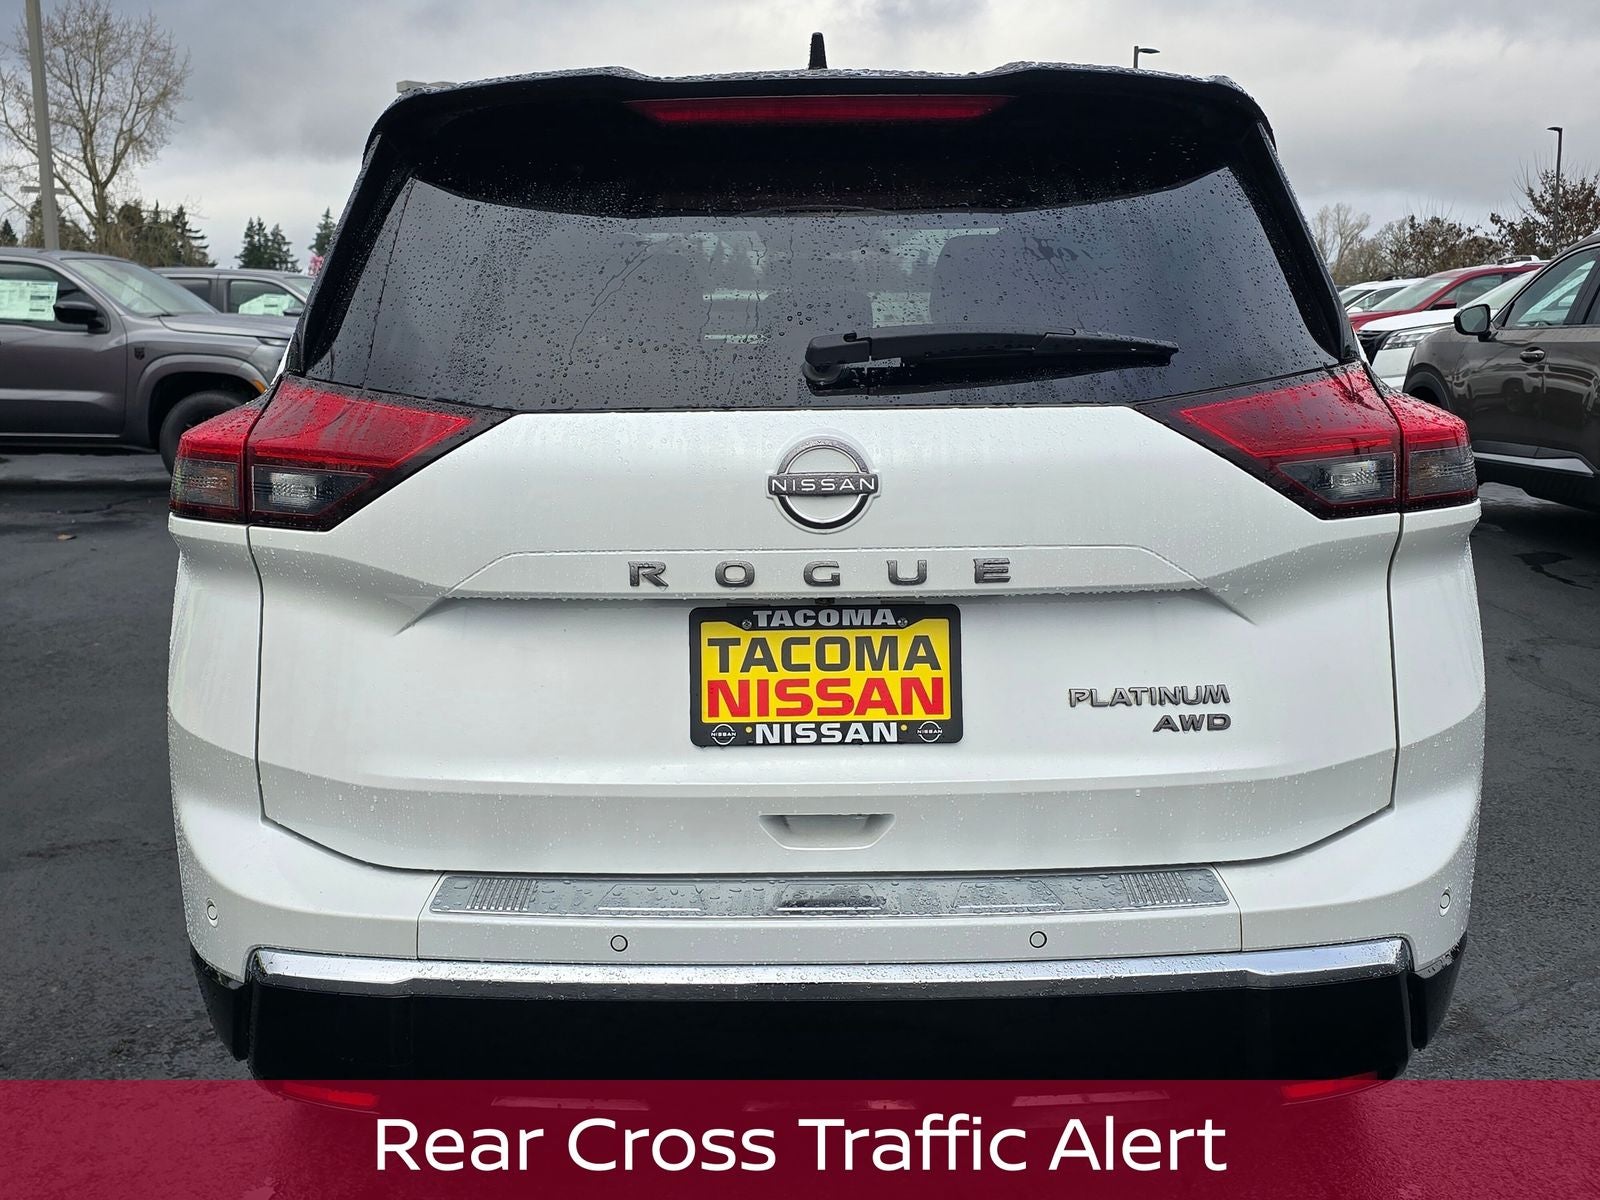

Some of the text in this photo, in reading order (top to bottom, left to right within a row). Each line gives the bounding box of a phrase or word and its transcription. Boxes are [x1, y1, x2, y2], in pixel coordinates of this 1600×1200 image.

[771, 475, 876, 492] NISSAN
[628, 558, 1012, 588] ROGUE
[752, 609, 896, 628] TACOMA
[707, 634, 942, 673] TACOMA
[706, 677, 945, 718] NISSAN
[1068, 684, 1231, 707] PLATINUM
[755, 722, 898, 744] NISSAN
[1153, 713, 1232, 732] AWD
